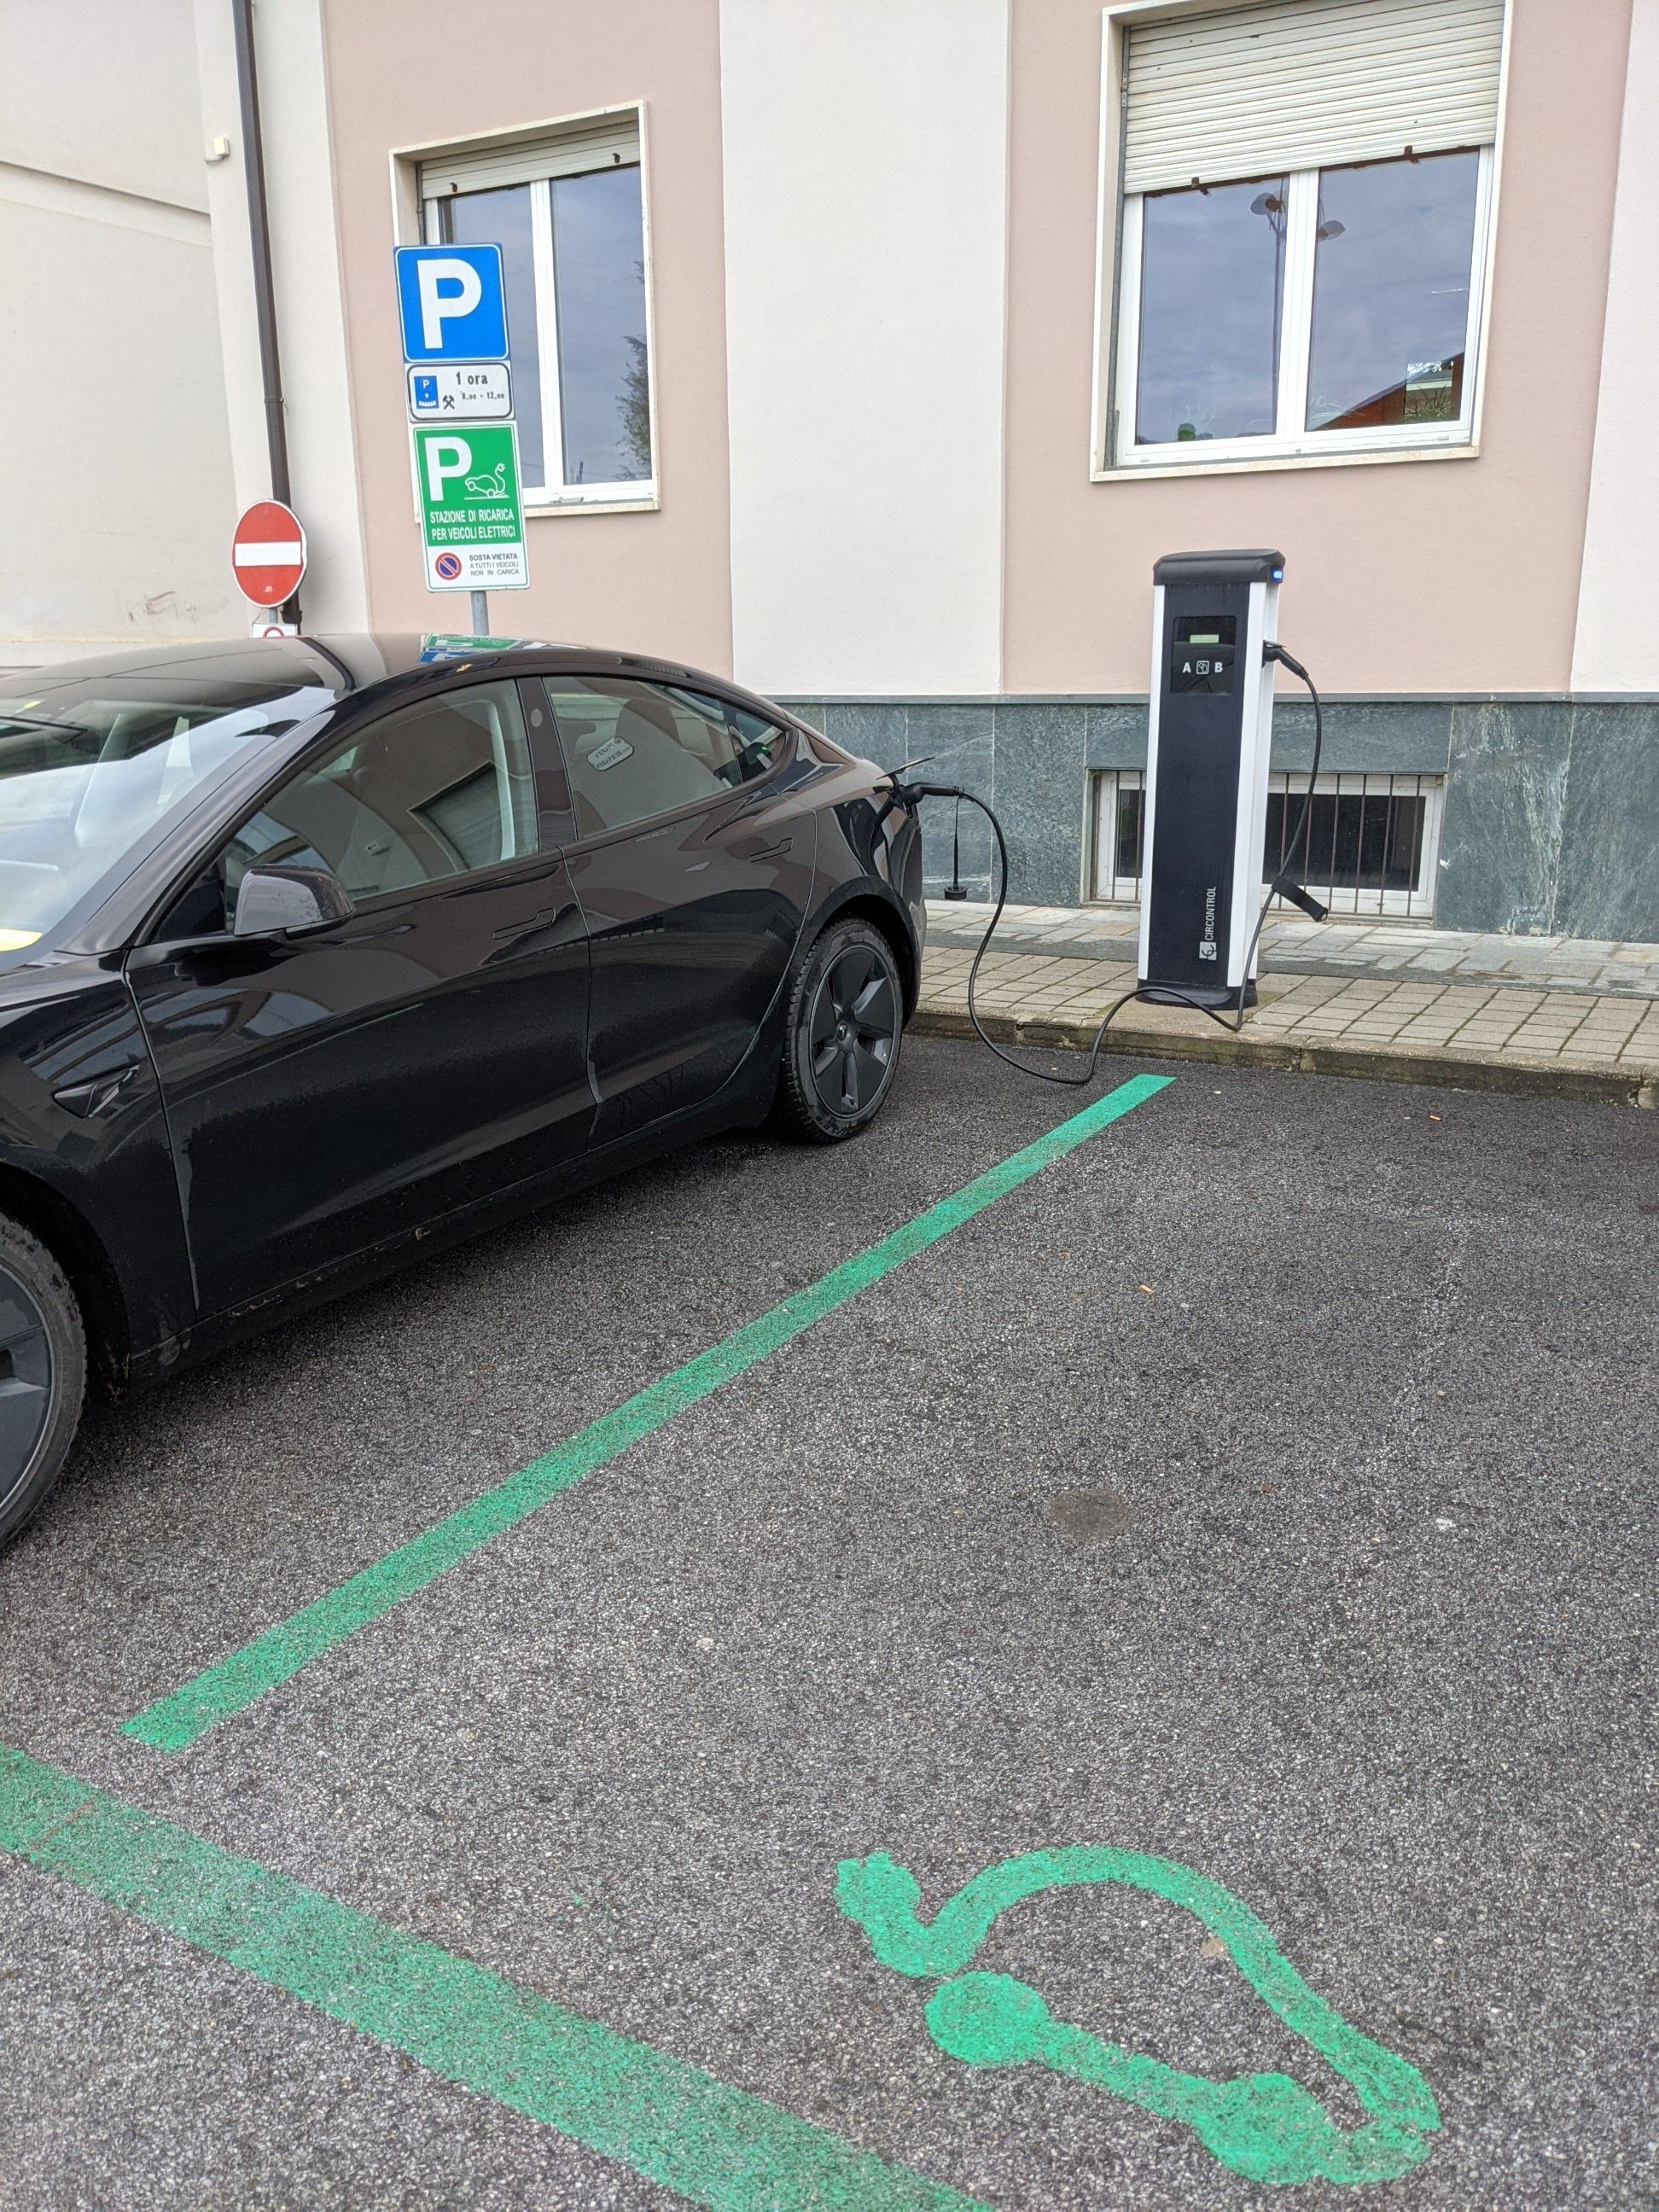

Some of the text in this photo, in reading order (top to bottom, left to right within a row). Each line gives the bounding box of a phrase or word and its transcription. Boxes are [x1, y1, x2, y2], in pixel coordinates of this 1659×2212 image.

[417, 259, 482, 349] P
[456, 371, 488, 385] 1 ora
[424, 436, 472, 501] P
[430, 509, 515, 524] STAZIONE DI RICARICA
[432, 525, 516, 540] PER VEICOLI ELETTRICI
[1182, 661, 1223, 673] A B
[1204, 886, 1216, 940] CIRCONTROL
